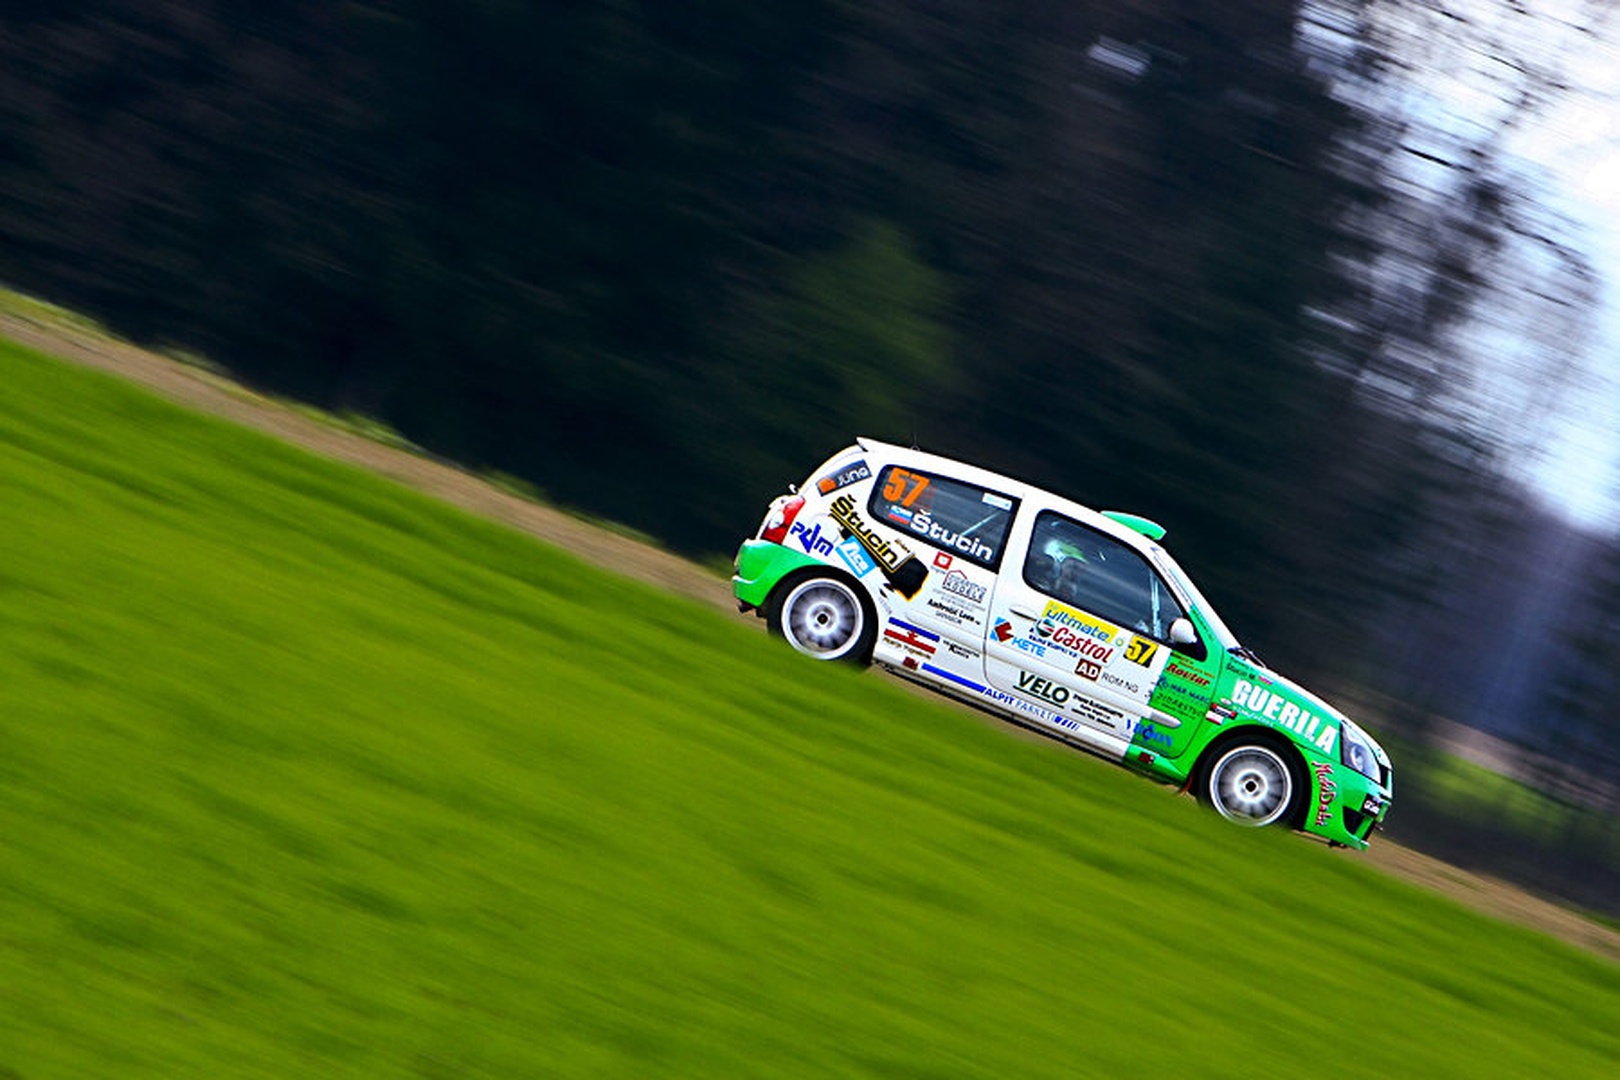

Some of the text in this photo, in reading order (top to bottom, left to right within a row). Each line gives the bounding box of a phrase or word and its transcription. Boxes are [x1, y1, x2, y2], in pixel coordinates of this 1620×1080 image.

[883, 467, 930, 507] 57
[831, 494, 898, 565] Štucin
[910, 508, 993, 561] Štucin
[1046, 608, 1110, 642] ultimate
[1011, 637, 1047, 657] KETE
[1052, 626, 1114, 664] Castrol
[1125, 634, 1159, 666] 57
[1018, 671, 1070, 703] VELO
[1077, 661, 1100, 679] AD
[1231, 679, 1341, 755] GUERILA
